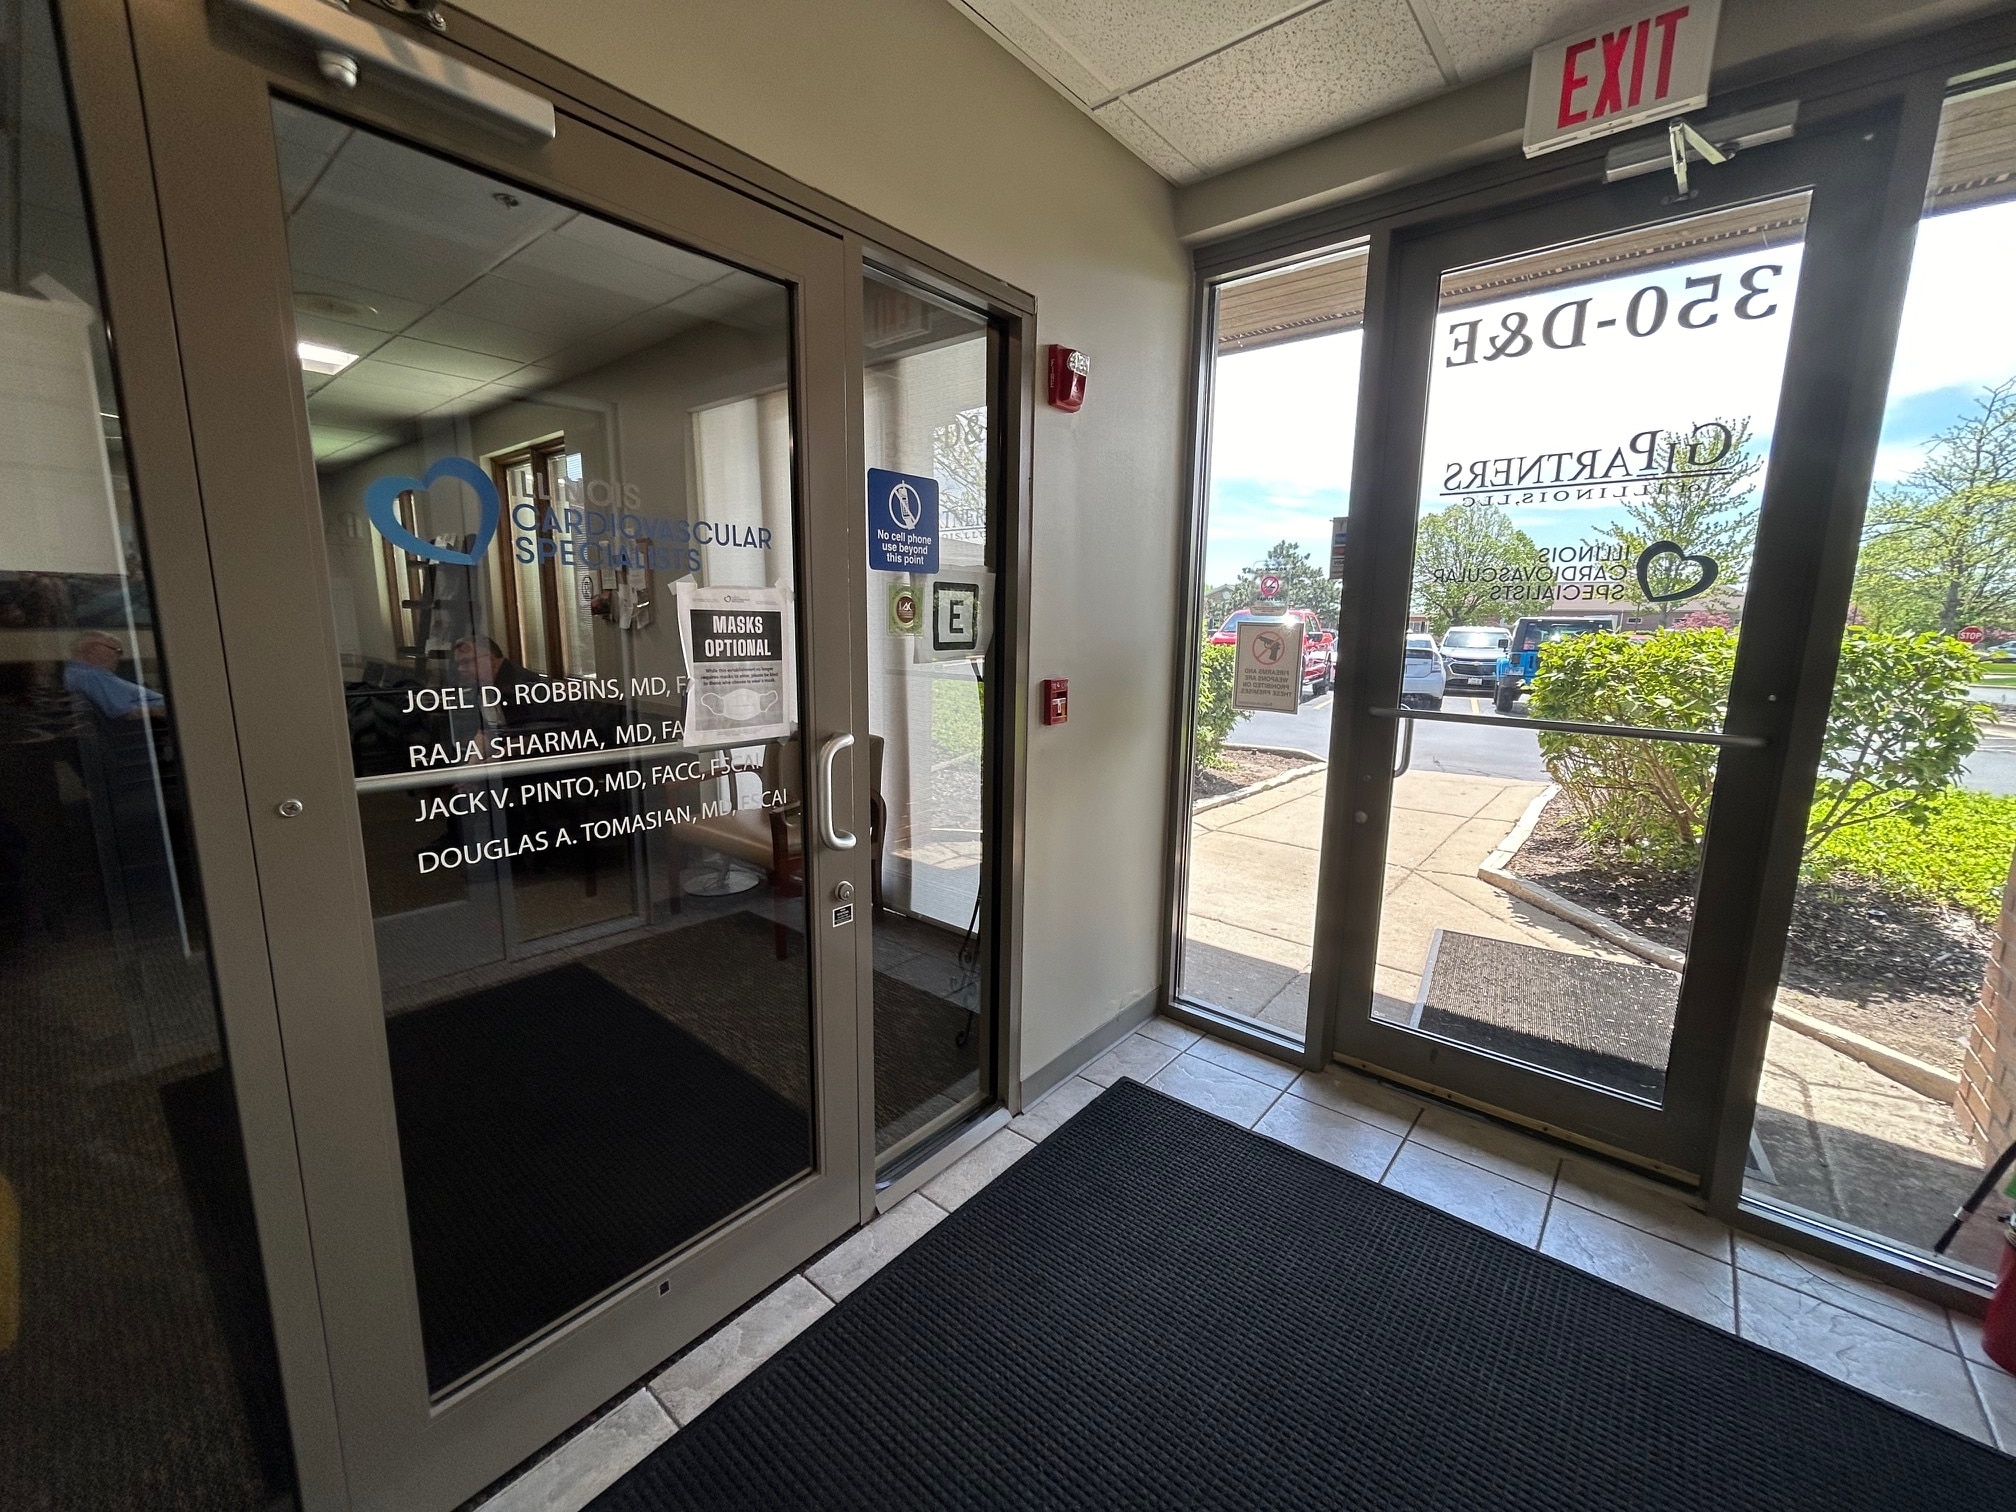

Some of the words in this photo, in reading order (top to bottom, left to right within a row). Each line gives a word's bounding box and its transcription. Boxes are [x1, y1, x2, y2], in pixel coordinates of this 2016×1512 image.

[1557, 6, 1689, 129] EXIT
[514, 470, 641, 509] ILLINOIS
[512, 503, 772, 549] CARDIOVASCULAR
[877, 529, 889, 540] No
[891, 531, 905, 542] cell
[908, 533, 932, 545] phone
[516, 537, 701, 571] SPECIALISTS
[882, 542, 897, 552] use
[899, 543, 928, 556] beyond
[886, 553, 902, 563] this
[904, 554, 924, 565] point
[713, 615, 763, 634] MASKS
[950, 600, 964, 634] E
[704, 639, 771, 657] OPTIONAL
[1960, 632, 1982, 640] STOP
[402, 687, 474, 714] JOEL
[481, 685, 508, 708] D.
[515, 678, 624, 704] ROBBINS,
[631, 676, 671, 697] MD,
[409, 740, 483, 768] RAJA
[491, 728, 606, 758] SHARMA,
[616, 723, 656, 744] MD,
[415, 791, 488, 823] JACK
[490, 788, 514, 809] V.
[521, 776, 600, 805] PINTO,
[605, 770, 647, 793] MD,
[652, 761, 706, 785] FACC,
[418, 831, 549, 874] DOUGLAS
[555, 827, 578, 848] A.
[580, 805, 697, 842] TOMASIAN,
[702, 801, 736, 820] MD,
[742, 788, 787, 810] FSCAI
